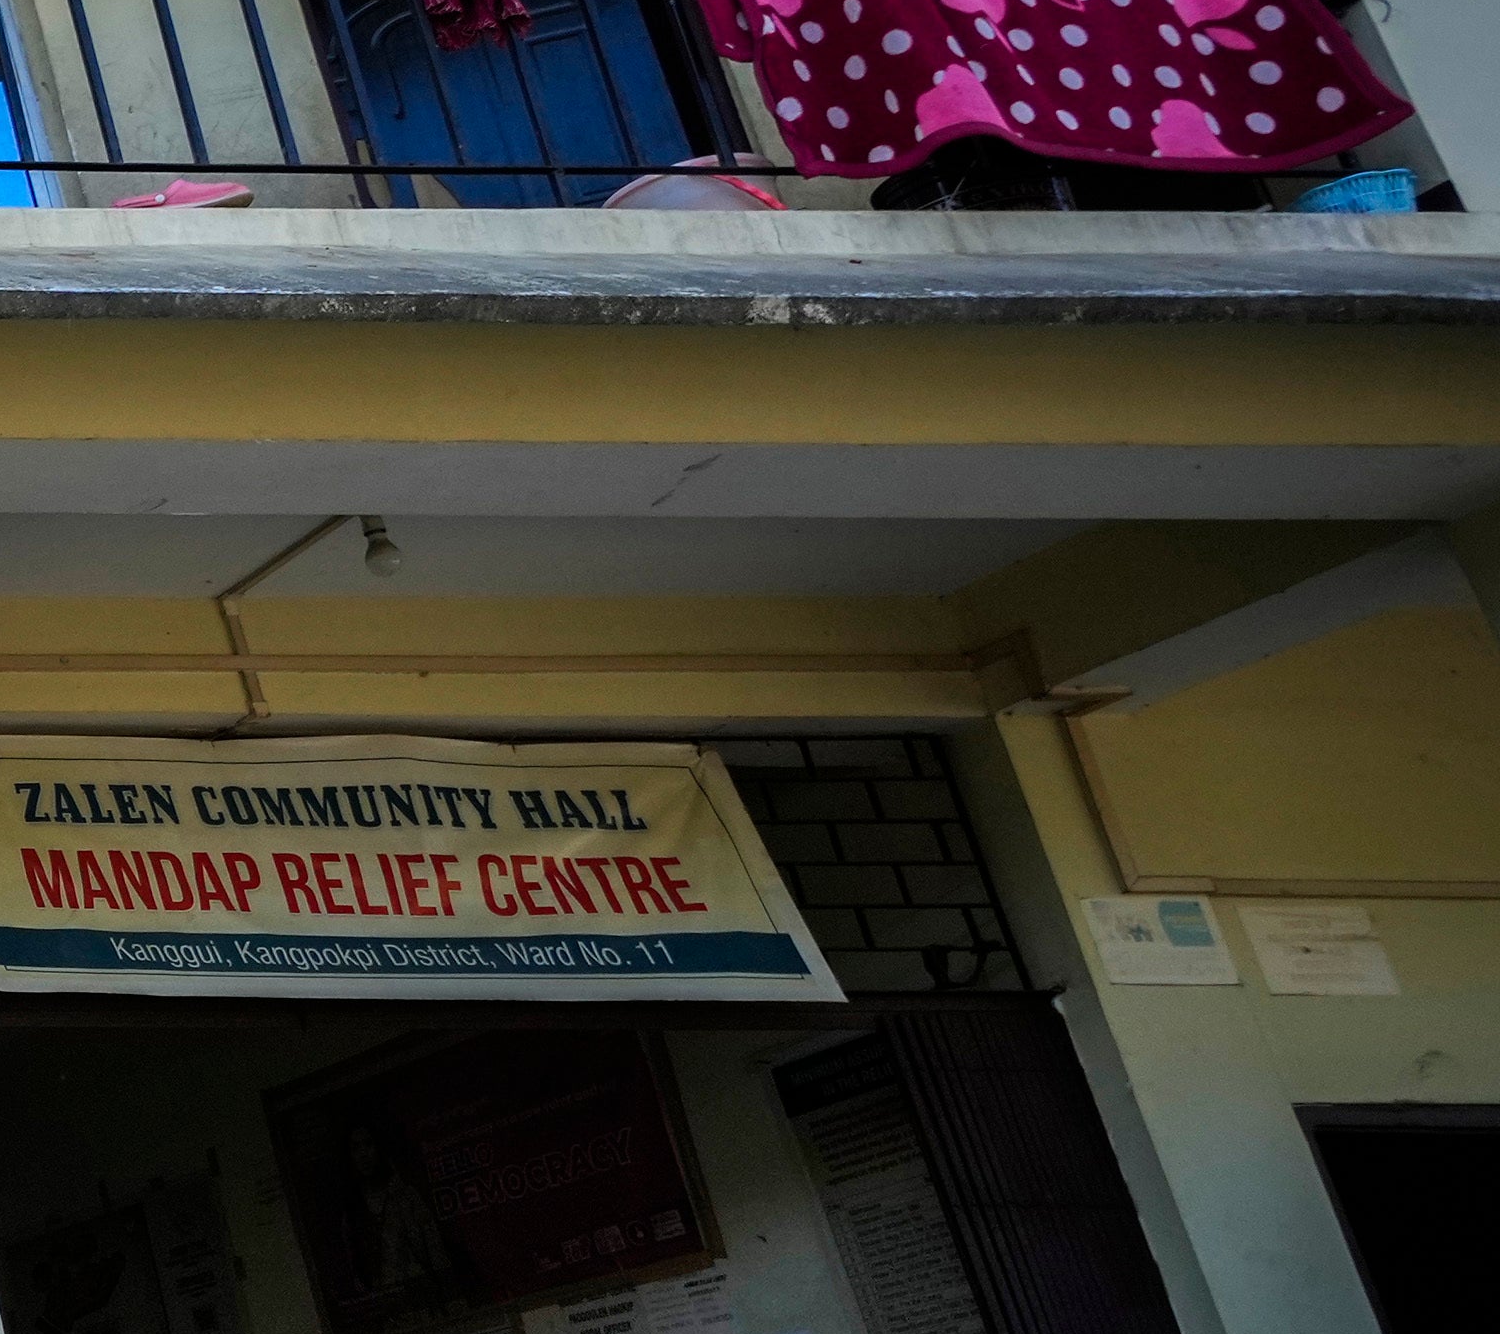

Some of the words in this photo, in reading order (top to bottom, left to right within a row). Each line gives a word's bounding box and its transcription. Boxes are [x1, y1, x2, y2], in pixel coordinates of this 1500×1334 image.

[15, 782, 180, 825] ZALEN
[192, 784, 497, 828] COMMUNITY
[509, 789, 647, 830] HALL
[21, 848, 261, 912] MANDAP
[272, 853, 461, 915] RELIEF
[477, 855, 708, 916] CENTRE
[110, 938, 232, 968] Kanggui,
[234, 941, 379, 971] Kangpokpi
[383, 943, 497, 968] District,
[499, 942, 575, 967] Ward
[580, 941, 631, 966] No.
[638, 941, 674, 965] 11
[433, 1128, 633, 1220] DEMOCRACY
